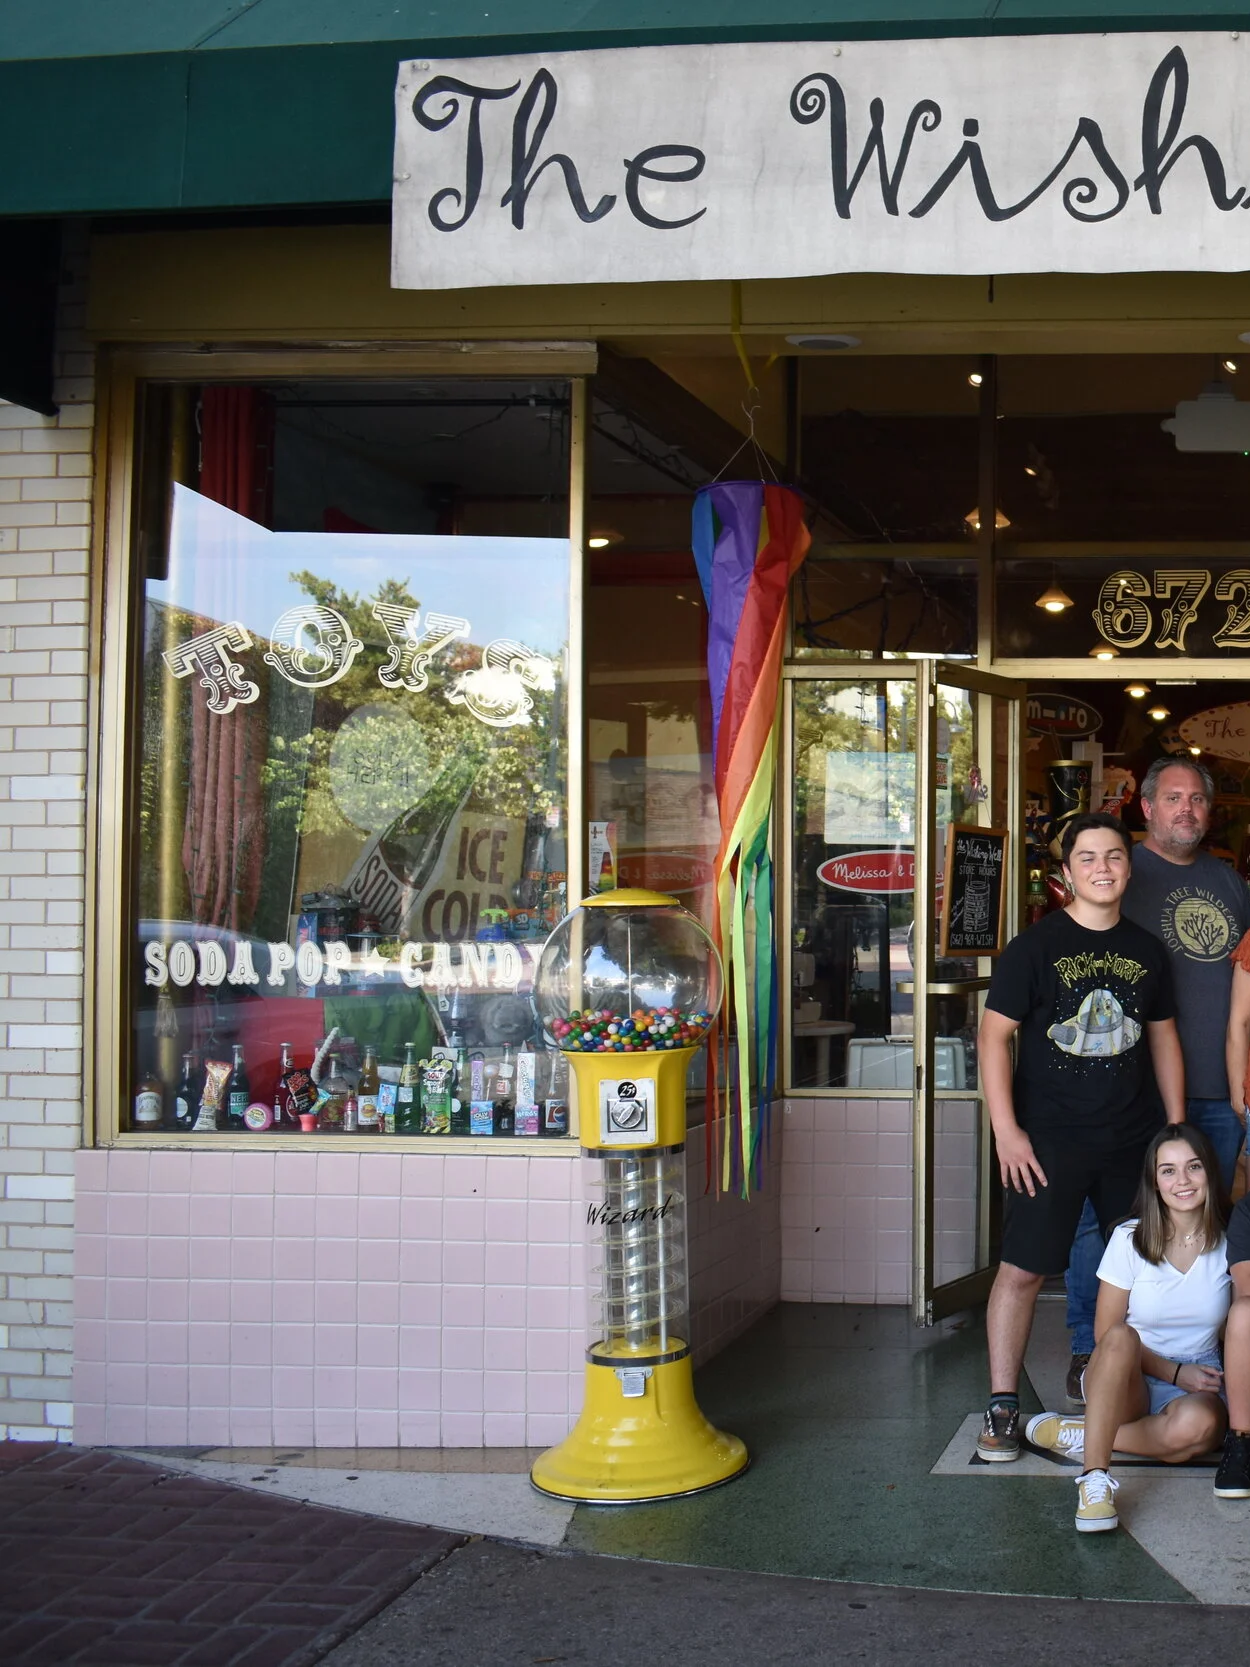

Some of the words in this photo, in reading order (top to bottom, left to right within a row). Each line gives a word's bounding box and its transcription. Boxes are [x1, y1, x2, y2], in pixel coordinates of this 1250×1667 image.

[411, 67, 707, 232] The
[161, 601, 556, 728] TOYS
[1204, 717, 1246, 738] The
[456, 826, 508, 884] ICE
[832, 862, 893, 883] Melissa
[897, 864, 905, 877] &
[959, 864, 976, 876] STORE
[1165, 886, 1193, 905] TREE
[1161, 907, 1184, 953] JOSHUA
[1195, 886, 1240, 949] WILDERNESS
[145, 940, 260, 987] SODA
[267, 941, 351, 986] POP
[400, 940, 560, 988] CANDY
[1053, 951, 1098, 988] RICK
[1103, 950, 1148, 985] MORTY
[586, 1193, 673, 1226] Wizard
